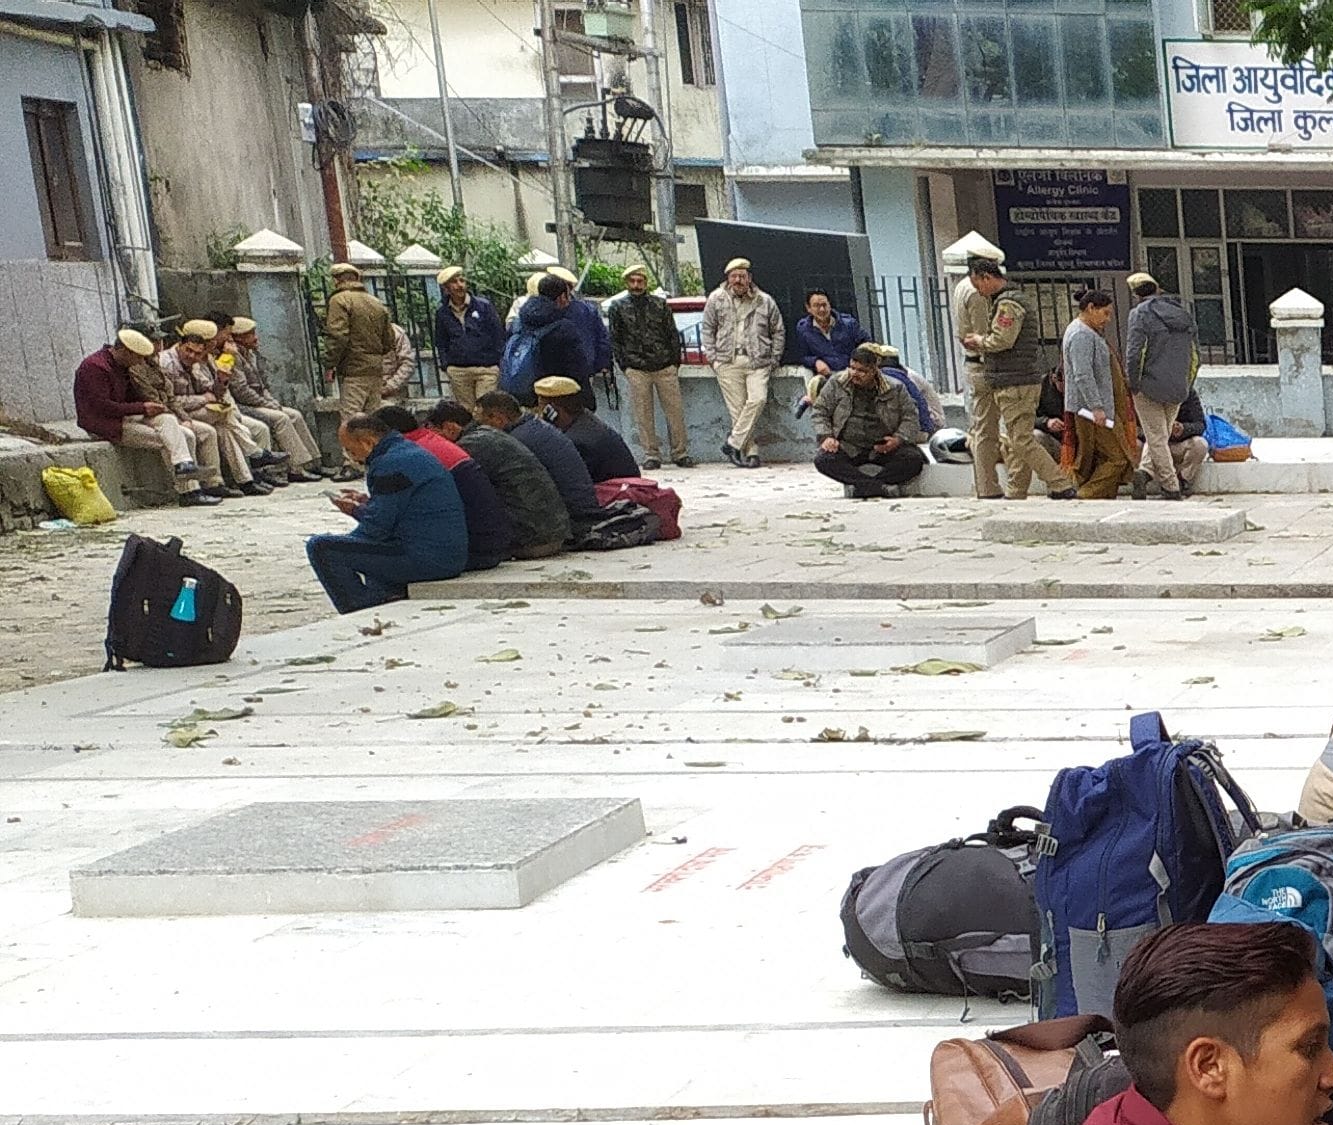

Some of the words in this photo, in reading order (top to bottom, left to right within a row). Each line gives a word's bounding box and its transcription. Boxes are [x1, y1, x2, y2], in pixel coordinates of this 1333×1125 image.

[1172, 55, 1227, 94] जिला
[1227, 101, 1284, 133] जिला
[1027, 185, 1065, 198] Allergy
[1067, 185, 1099, 195] Clinic
[1272, 887, 1286, 897] THE
